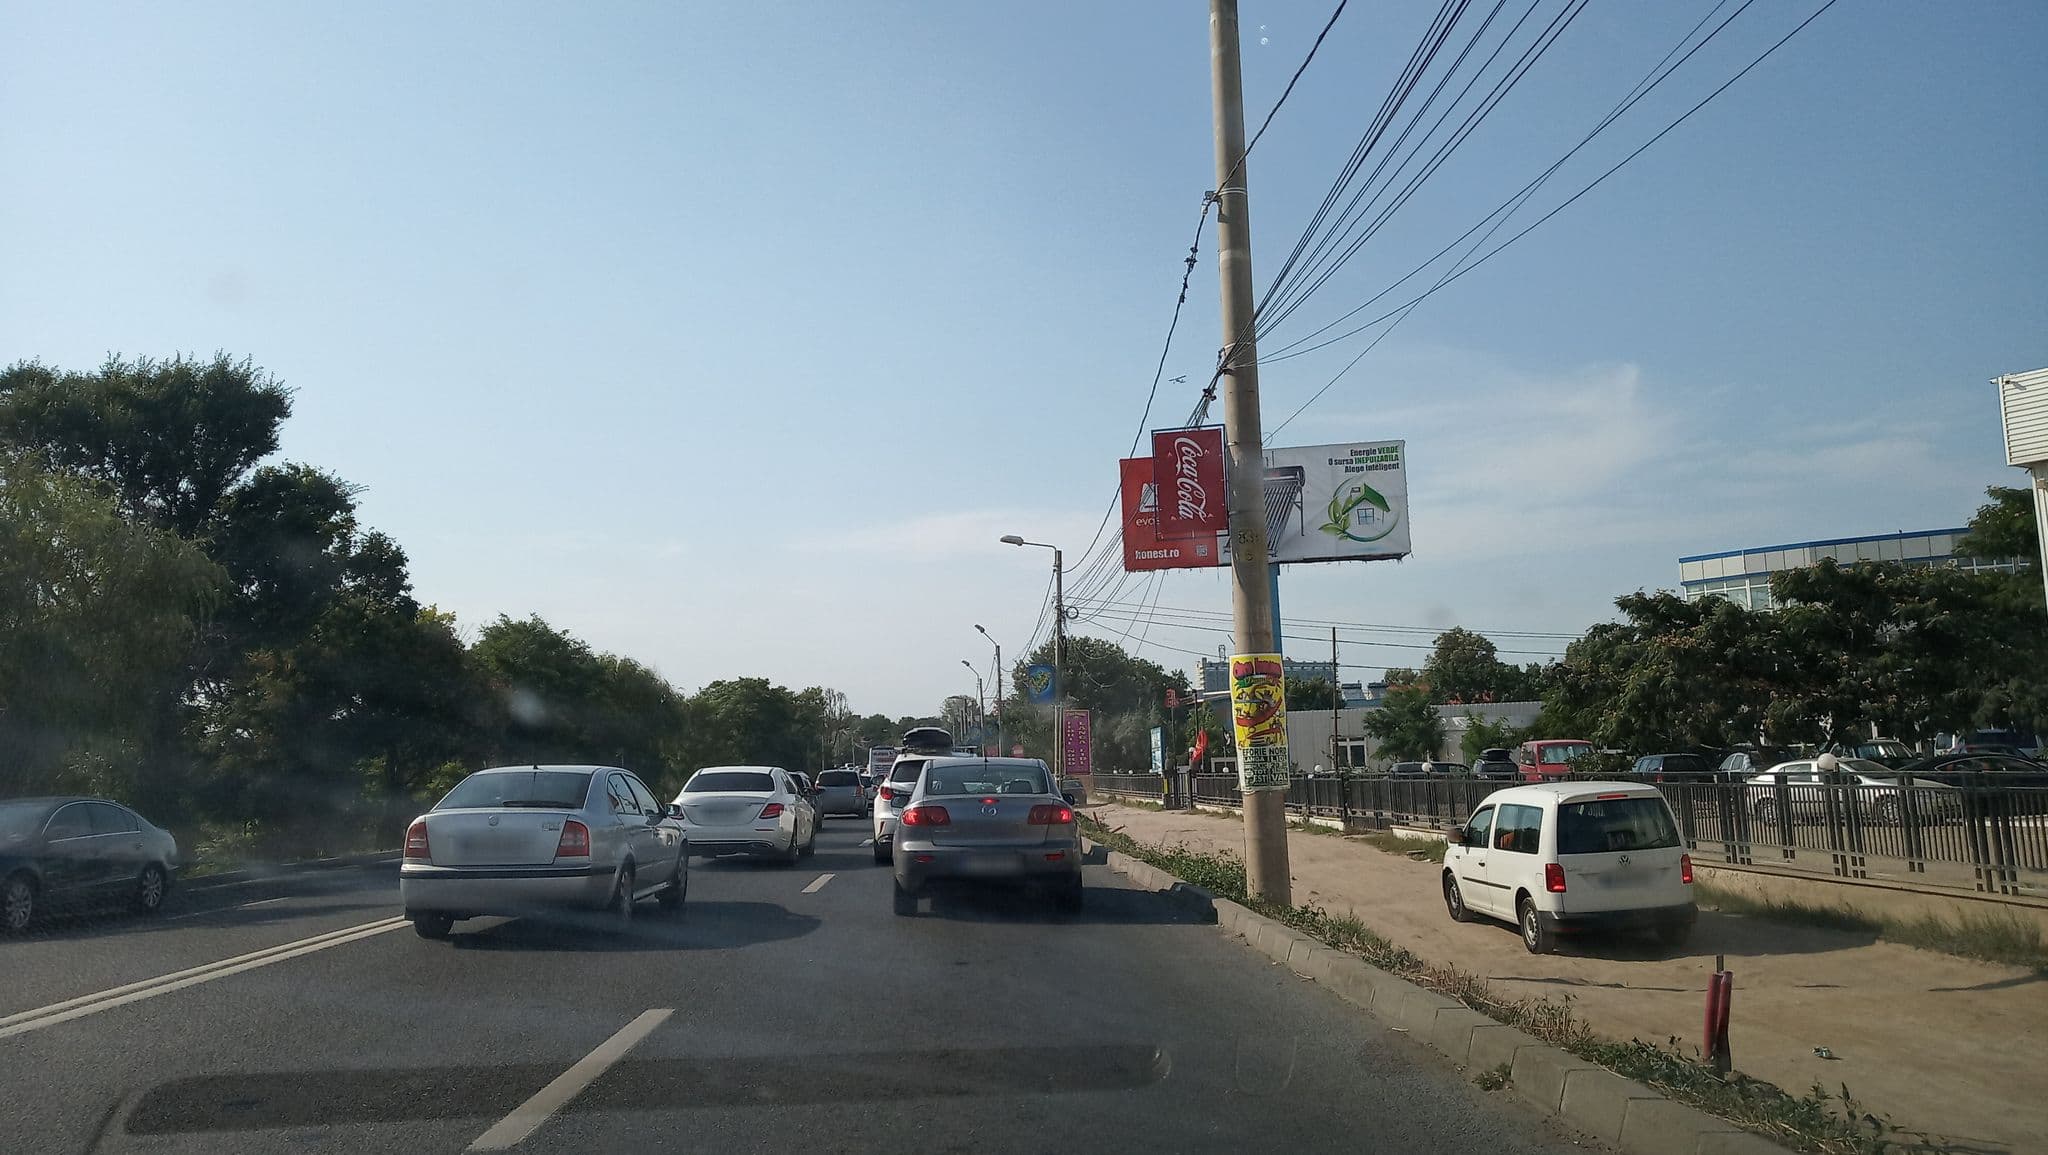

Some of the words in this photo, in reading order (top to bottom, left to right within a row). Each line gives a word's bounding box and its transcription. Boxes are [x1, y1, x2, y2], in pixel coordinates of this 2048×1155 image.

[1350, 448, 1377, 456] Energie
[1378, 446, 1399, 454] VERDE
[1243, 747, 1267, 756] EFORIE
